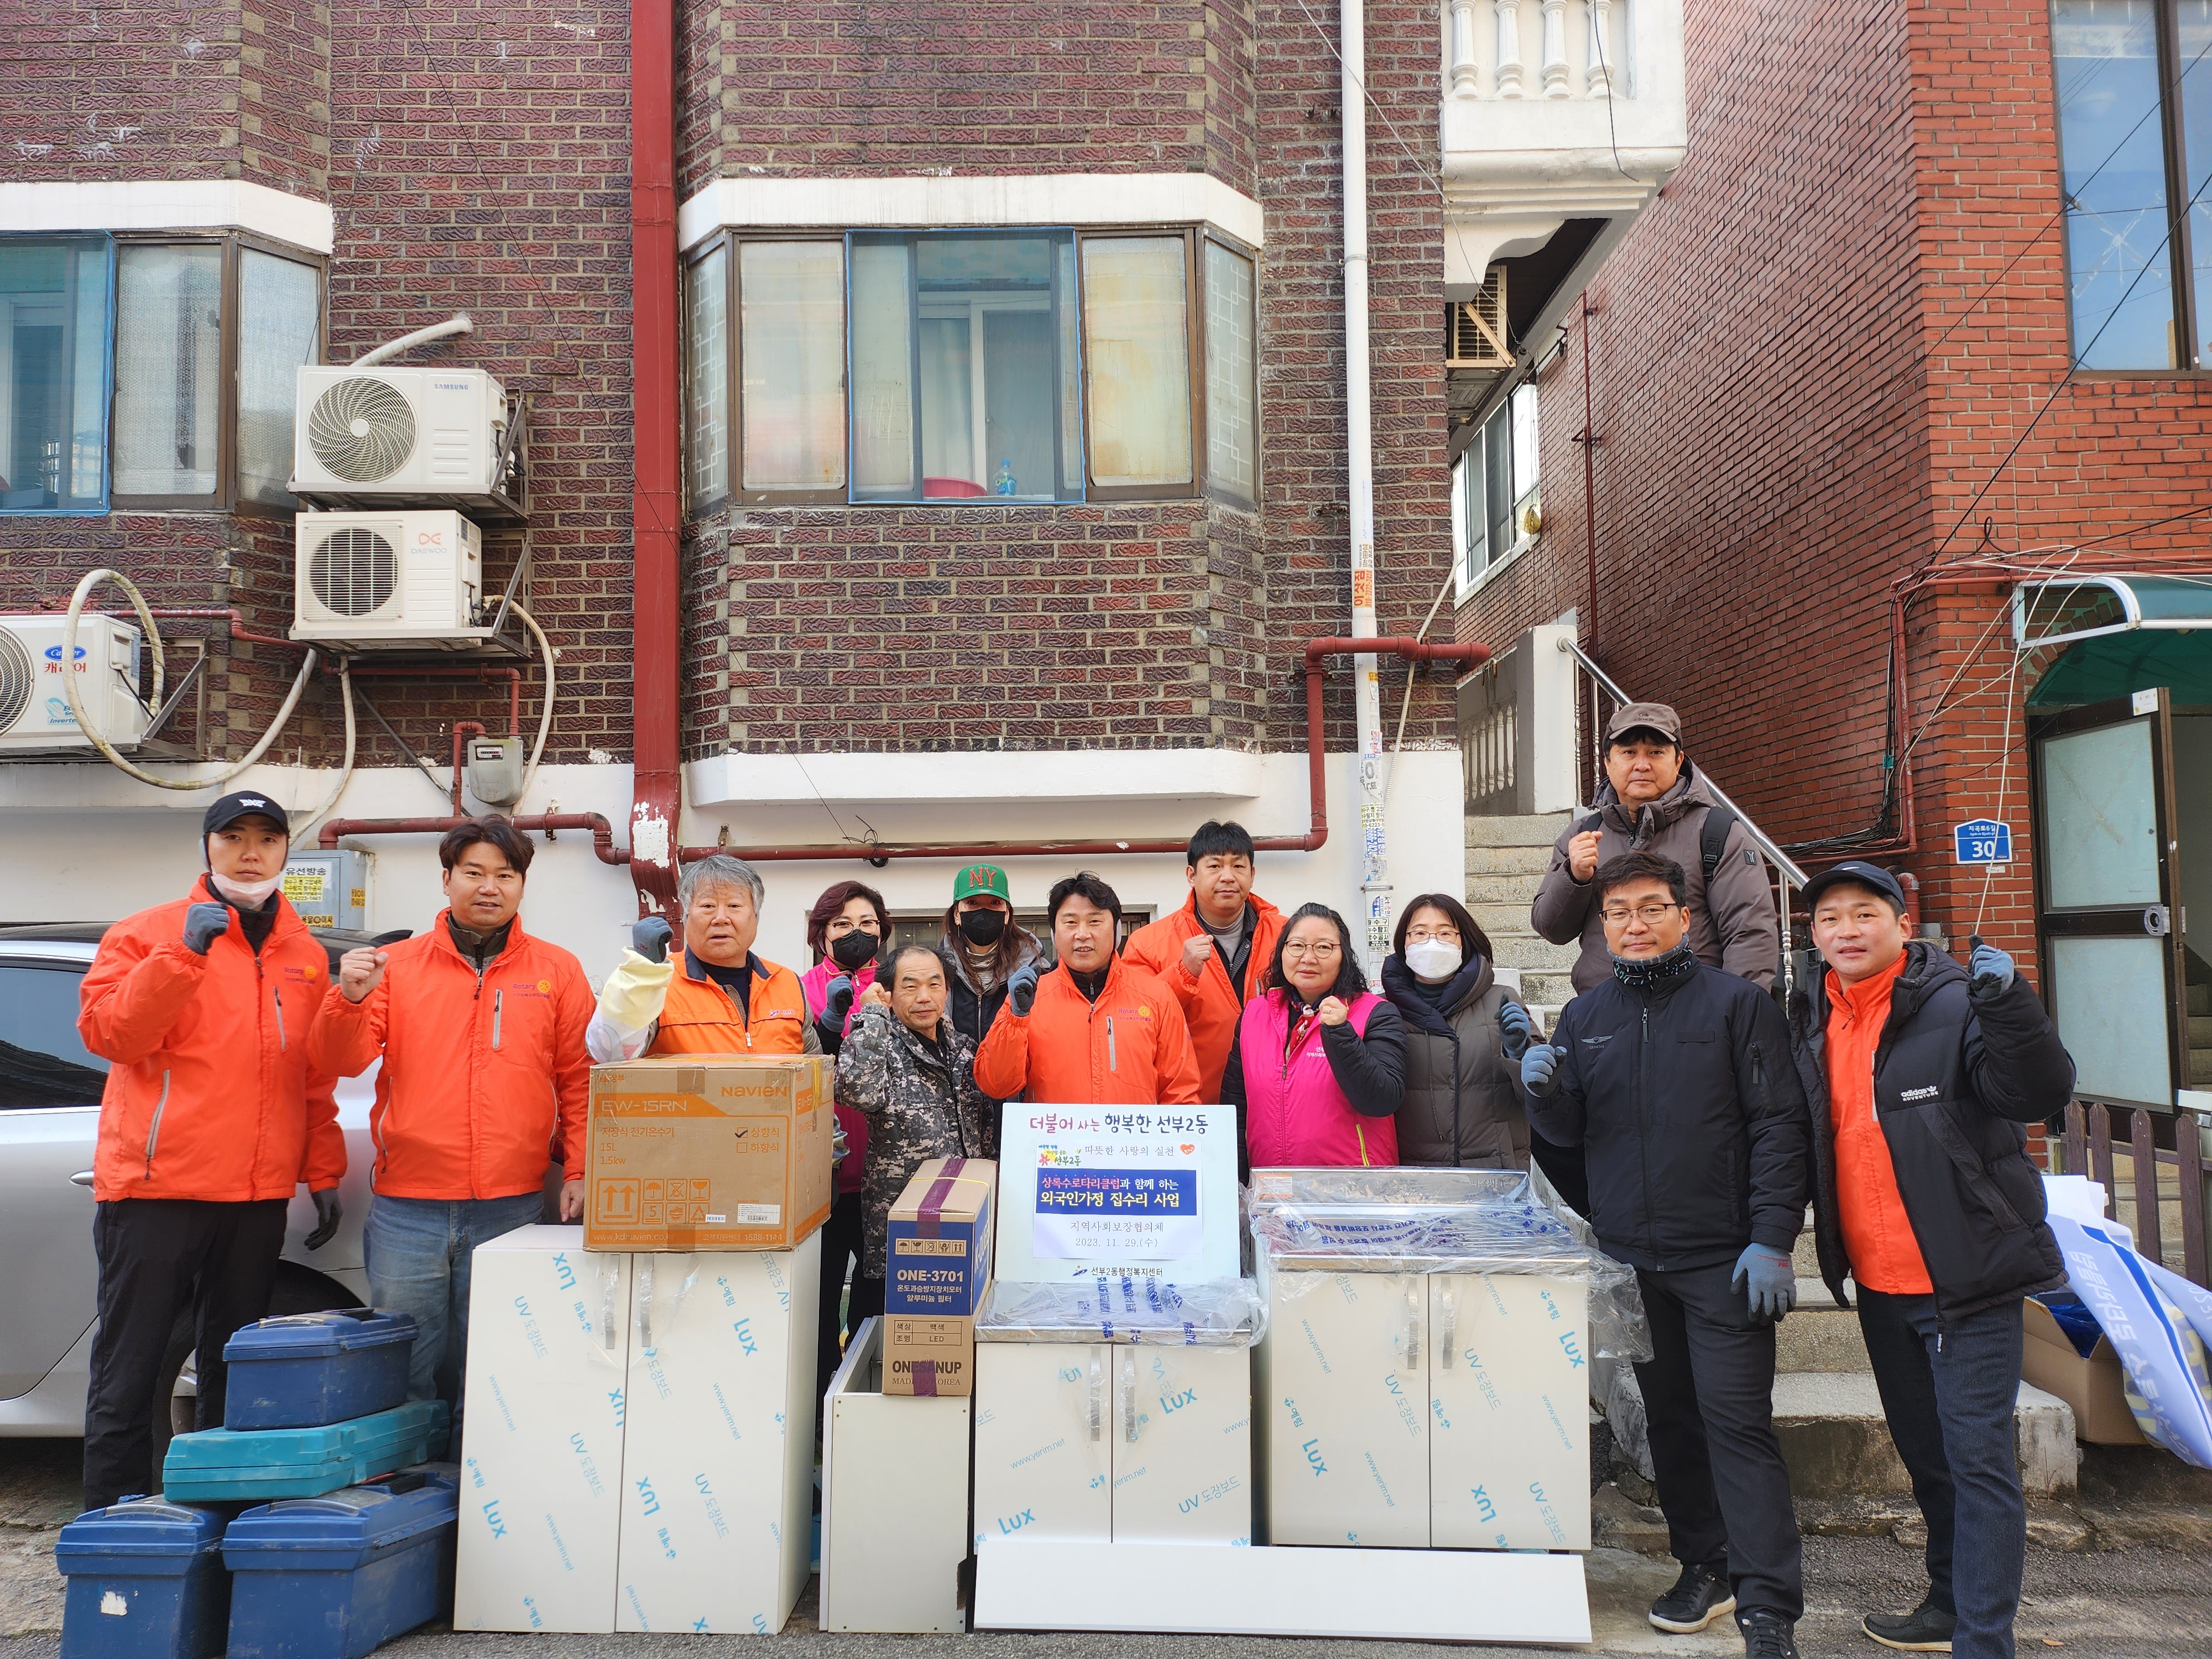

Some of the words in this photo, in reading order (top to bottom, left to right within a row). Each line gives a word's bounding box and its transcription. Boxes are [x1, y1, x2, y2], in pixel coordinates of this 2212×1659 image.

[1354, 571, 1365, 606] 이삿짐
[1972, 841, 1995, 858] 30
[286, 868, 327, 876] 유선방송
[970, 867, 997, 888] NY
[1901, 1088, 1928, 1097] adidas
[1902, 1091, 1939, 1102] ADVENTURE
[601, 1100, 687, 1112] EW-15RN
[601, 1127, 628, 1138] 저장식
[631, 1126, 674, 1138] 전기온수기
[751, 1127, 780, 1138] 상향식
[1030, 1113, 1073, 1134] 더불어
[1077, 1118, 1100, 1132] 사는
[1104, 1113, 1152, 1134] 행복한
[1156, 1114, 1209, 1134] 선부2동
[600, 1142, 617, 1151] 15L
[750, 1142, 779, 1153] 하향식
[1084, 1145, 1114, 1156] 따뜻한
[1119, 1145, 1148, 1156] 사랑의
[1155, 1146, 1174, 1156] 실천
[600, 1156, 626, 1165] 1.5kw
[1054, 1155, 1081, 1167] 선부2동
[1041, 1177, 1131, 1190] 상록수로타리클럽과
[1135, 1178, 1154, 1190] 함께
[1159, 1179, 1179, 1190] 하는
[1040, 1191, 1104, 1207] 외국인가정
[1109, 1192, 1147, 1207] 집수리
[1154, 1192, 1180, 1207] 사업
[1070, 1220, 1164, 1233] 지역사회보장협의체
[703, 1233, 740, 1242] 고객지원센터
[744, 1233, 782, 1241] 1588-1144
[1076, 1238, 1100, 1246] 2023.
[1106, 1238, 1119, 1246] 11.
[552, 1252, 576, 1290] LUX
[897, 1270, 963, 1282] ONE-3701
[1091, 1266, 1162, 1277] 선부2동행정복지센터
[897, 1285, 962, 1294] 온도과승방지장치모터
[906, 1294, 935, 1303] 알루미늄
[937, 1294, 952, 1303] 필터
[514, 1296, 532, 1316] UV
[1547, 1300, 1561, 1320] 예림
[733, 1317, 758, 1357] LUX
[896, 1322, 911, 1331] 색상
[930, 1322, 945, 1331] 백색
[896, 1334, 911, 1343] 조명
[1302, 1319, 1332, 1375] www.yerim.net
[1558, 1331, 1585, 1369] LUX
[648, 1359, 672, 1400] 도장보드
[1464, 1348, 1483, 1369] UV
[1475, 1371, 1502, 1411] 도장보드
[489, 1374, 517, 1432] www.yerim.net
[713, 1382, 742, 1440] www.yerim.net
[1159, 1387, 1198, 1414] LUX
[1385, 1374, 1404, 1395] UV
[1396, 1397, 1422, 1438] 도장보드
[1290, 1407, 1304, 1428] 예림
[1542, 1394, 1573, 1451] www.yerim.net
[571, 1433, 588, 1454] UV
[1010, 1438, 1066, 1470] www.yerim.net
[1302, 1438, 1329, 1478] LUX
[695, 1473, 713, 1495] UV
[1365, 1451, 1396, 1509] www.yerim.net
[636, 1475, 661, 1517] LUX
[1178, 1495, 1199, 1514] UV
[1201, 1475, 1241, 1504] 도장보드
[1471, 1484, 1497, 1523] LUX
[482, 1499, 508, 1540] LUX
[998, 1508, 1036, 1536] LUX
[1529, 1481, 1548, 1503] UV
[1540, 1505, 1567, 1546] 도장보드
[545, 1512, 575, 1572] www.yerim.net
